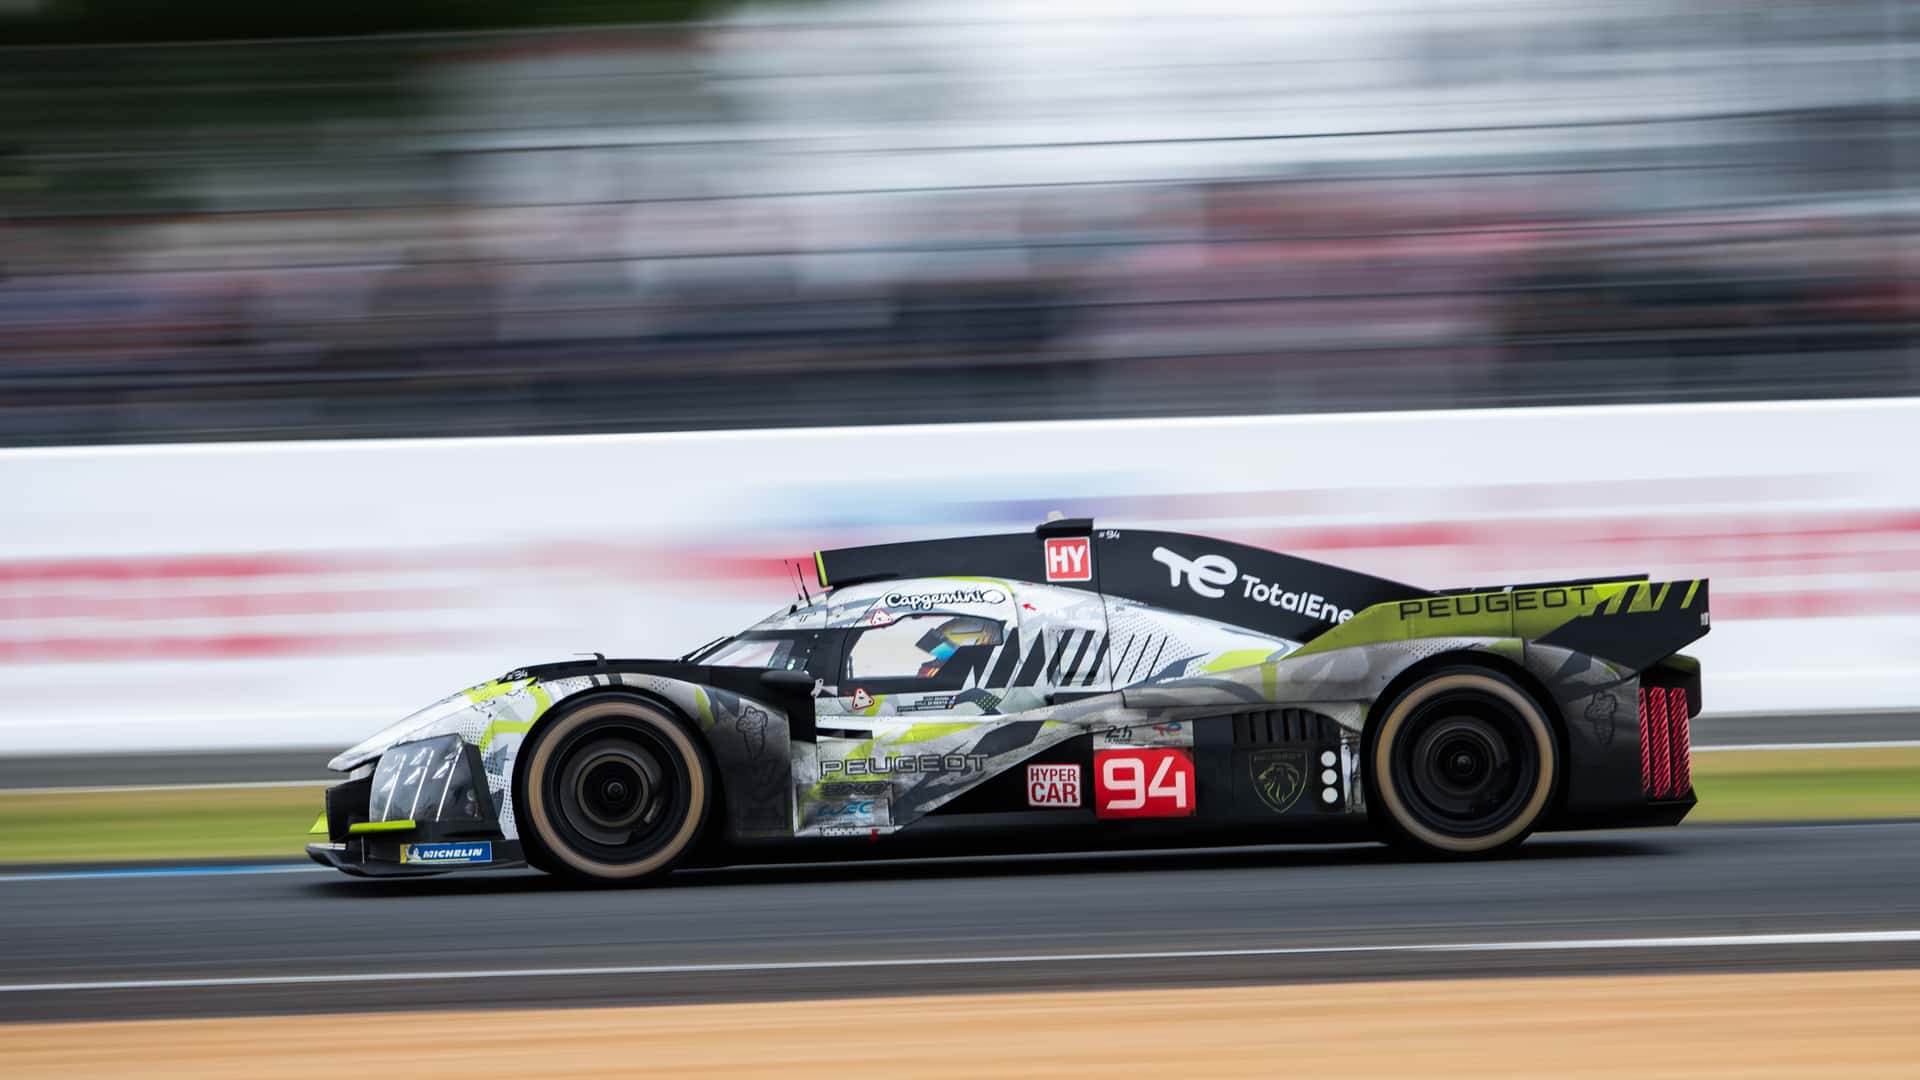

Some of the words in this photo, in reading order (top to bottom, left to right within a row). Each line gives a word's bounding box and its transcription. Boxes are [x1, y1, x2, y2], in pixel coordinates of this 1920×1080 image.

[1049, 545, 1086, 573] HY
[885, 590, 984, 612] Capgemini
[1399, 587, 1594, 621] PEUGEOT
[820, 753, 989, 779] PEUGEOT
[1030, 767, 1077, 782] HYPER
[1031, 782, 1079, 803] CAR
[1103, 756, 1187, 810] 94
[422, 848, 483, 859] MICHELIN
